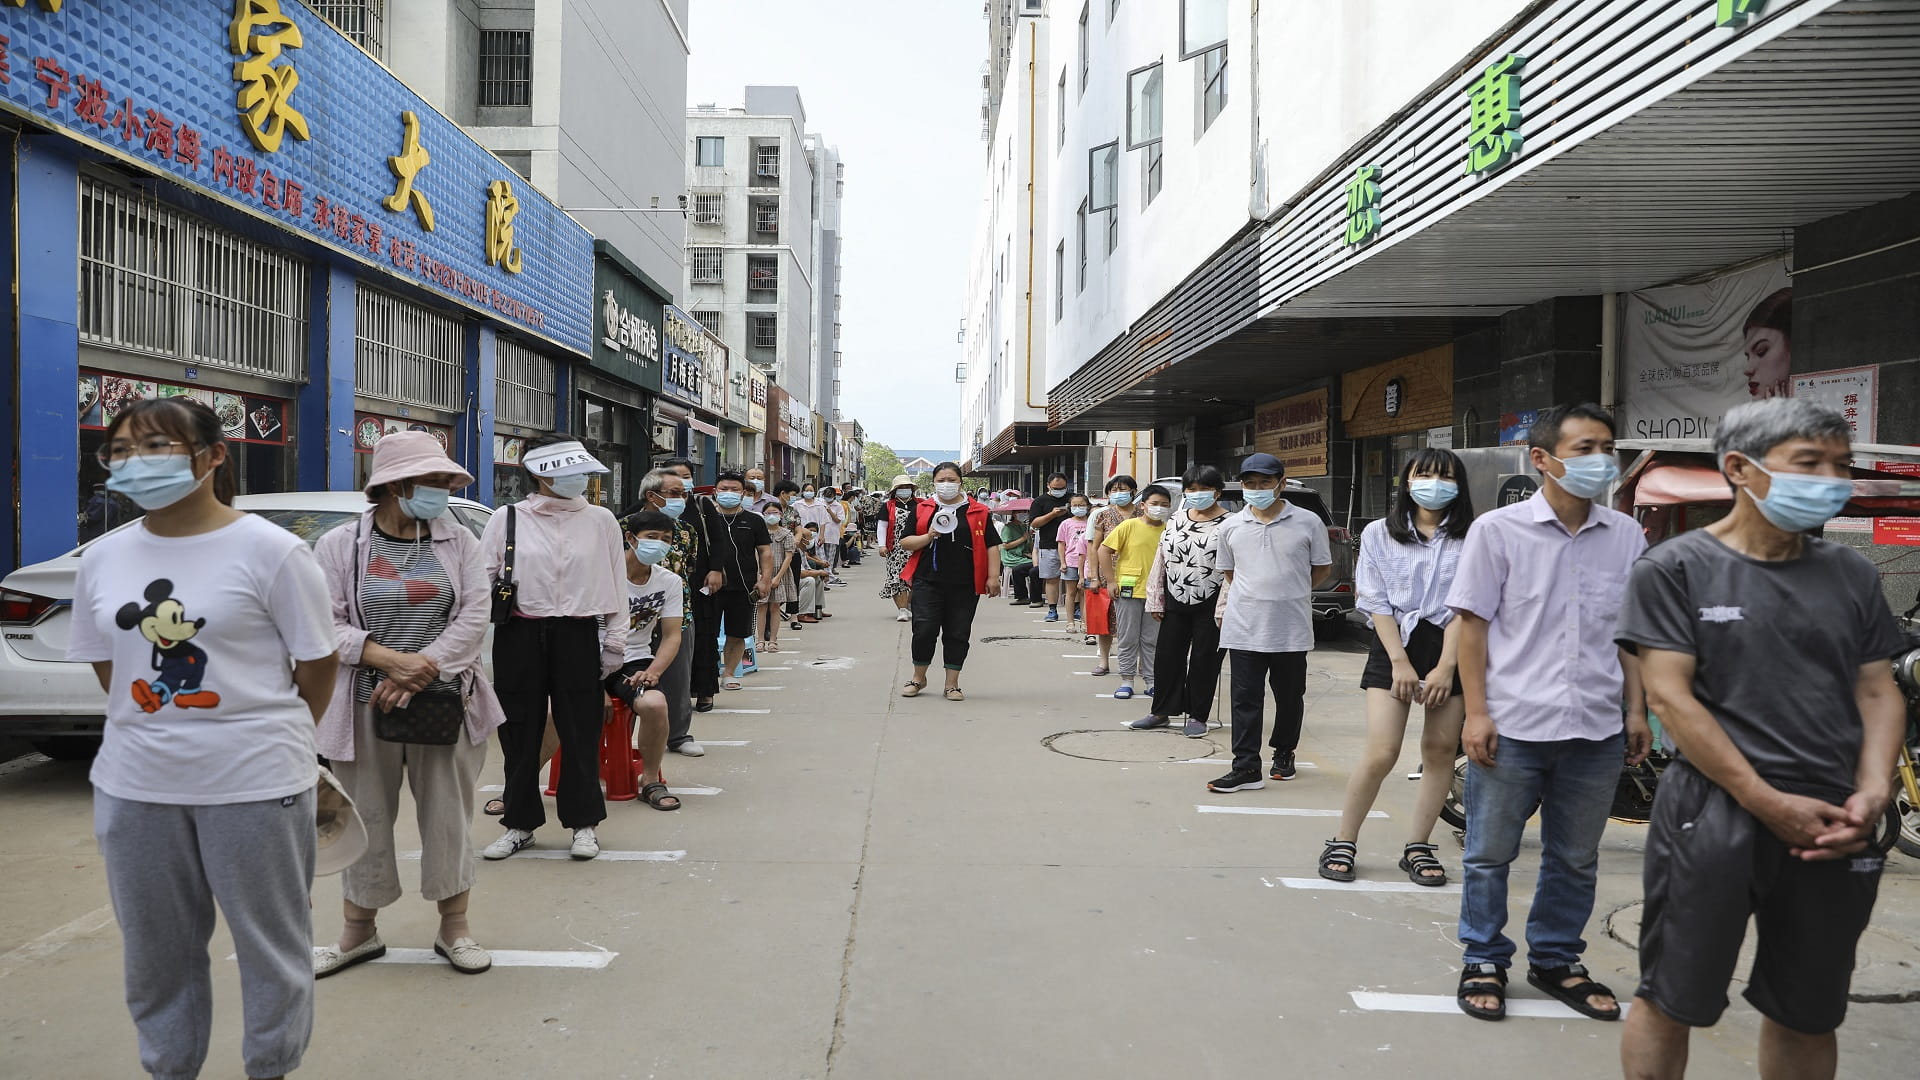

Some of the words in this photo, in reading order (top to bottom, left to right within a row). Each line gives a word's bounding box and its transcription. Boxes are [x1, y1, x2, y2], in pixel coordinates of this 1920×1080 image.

[35, 55, 202, 172] 宁波小海鲜
[213, 144, 304, 219] 内设包厢
[312, 194, 384, 256] 承接家宴
[389, 236, 417, 272] 电话
